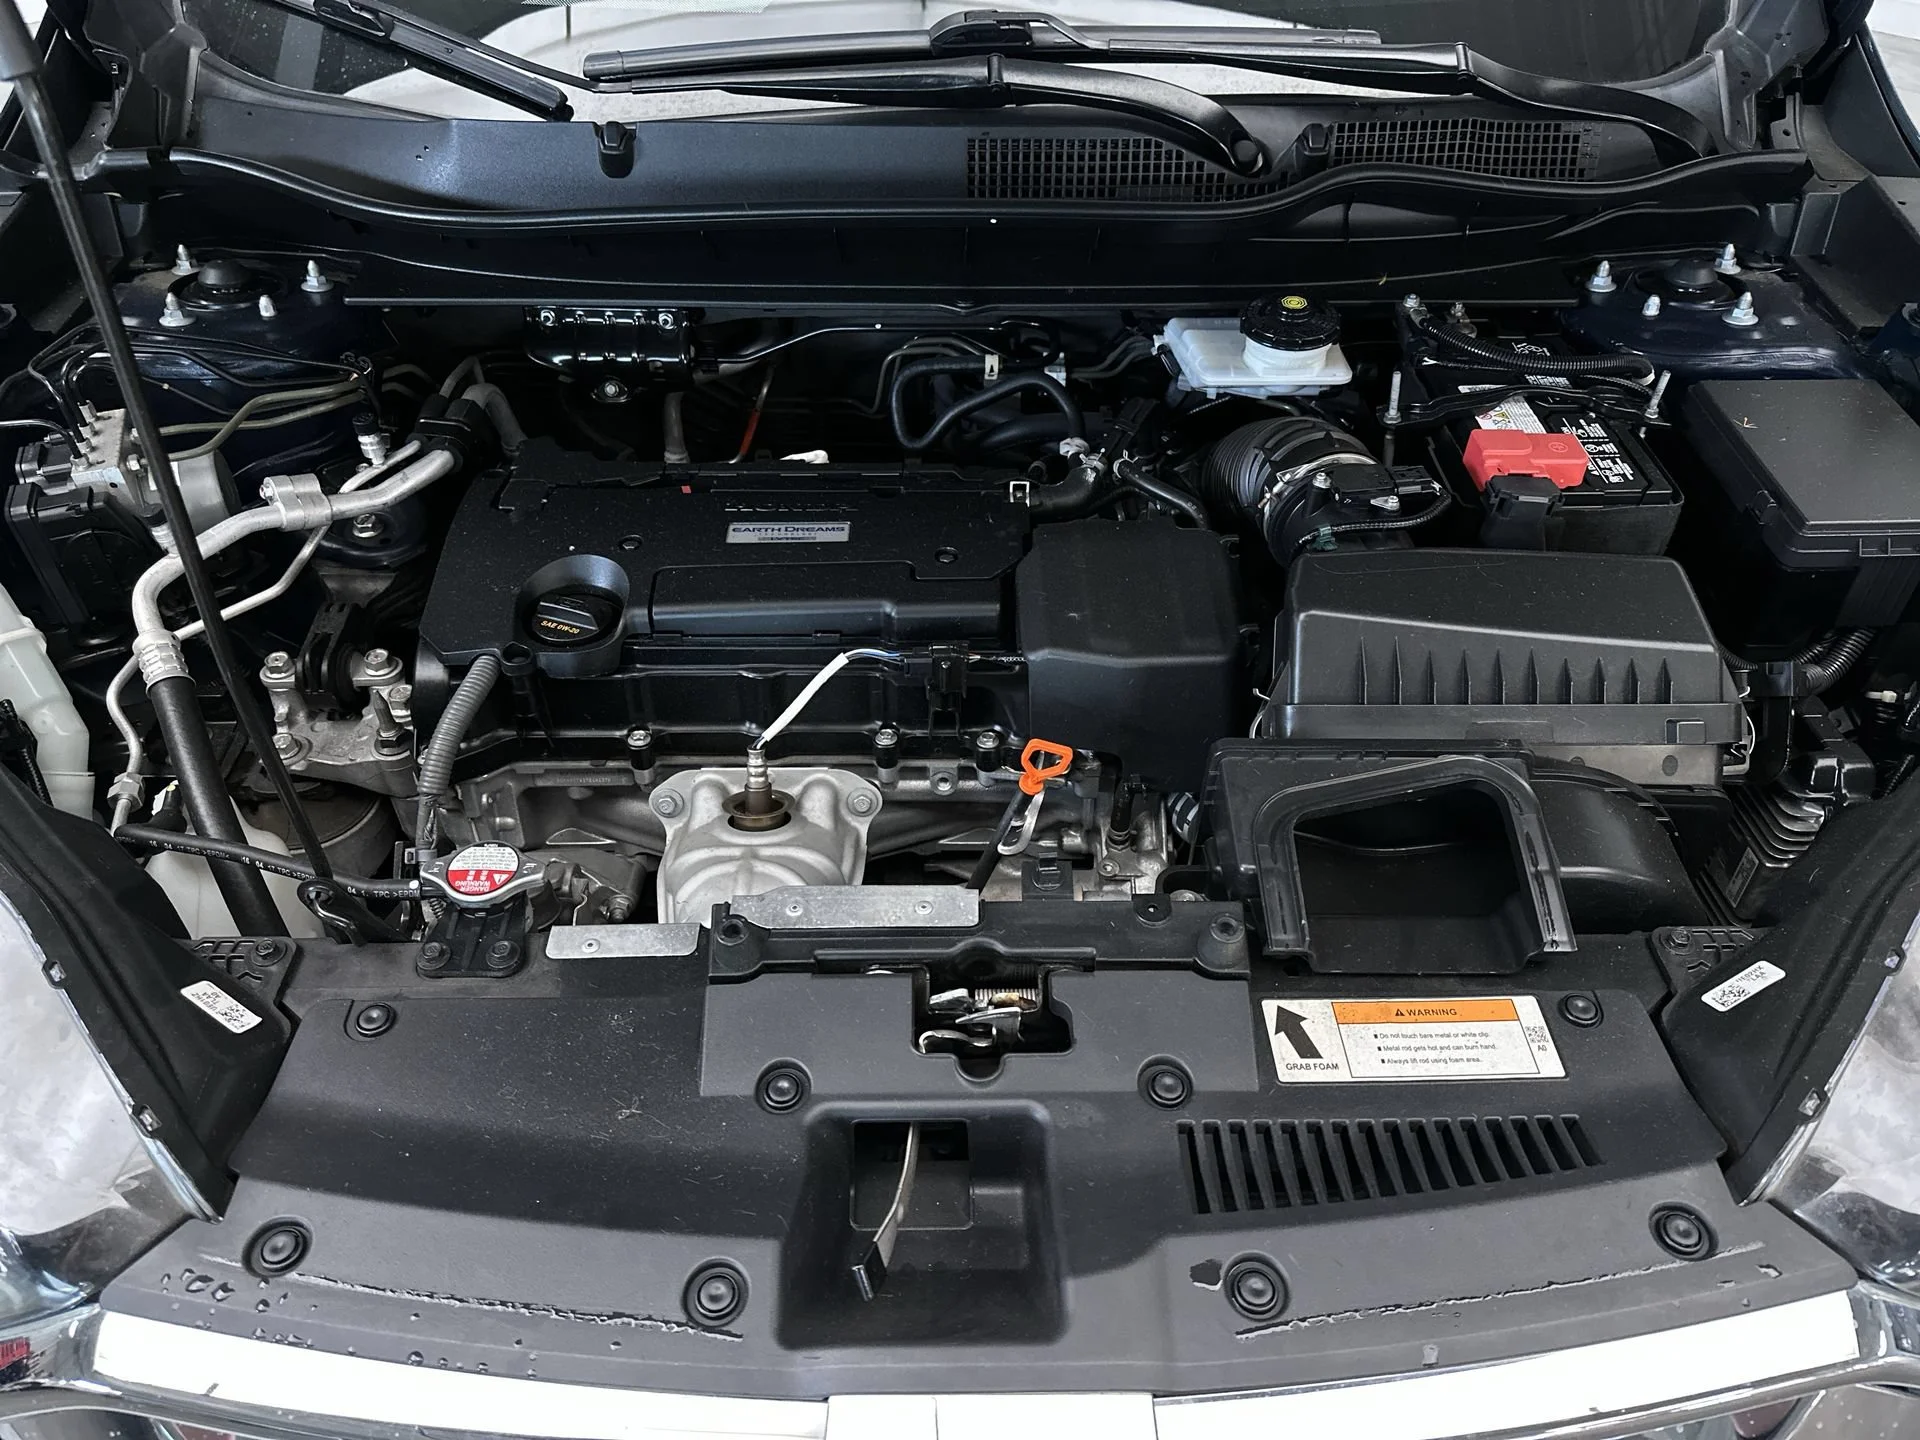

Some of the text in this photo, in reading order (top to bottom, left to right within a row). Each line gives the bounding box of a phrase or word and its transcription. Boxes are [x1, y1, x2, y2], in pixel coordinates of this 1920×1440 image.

[540, 621, 580, 634] SAE 0W-20
[277, 867, 291, 876] TPC
[373, 890, 390, 898] TPC
[1406, 1008, 1457, 1016] WARNING
